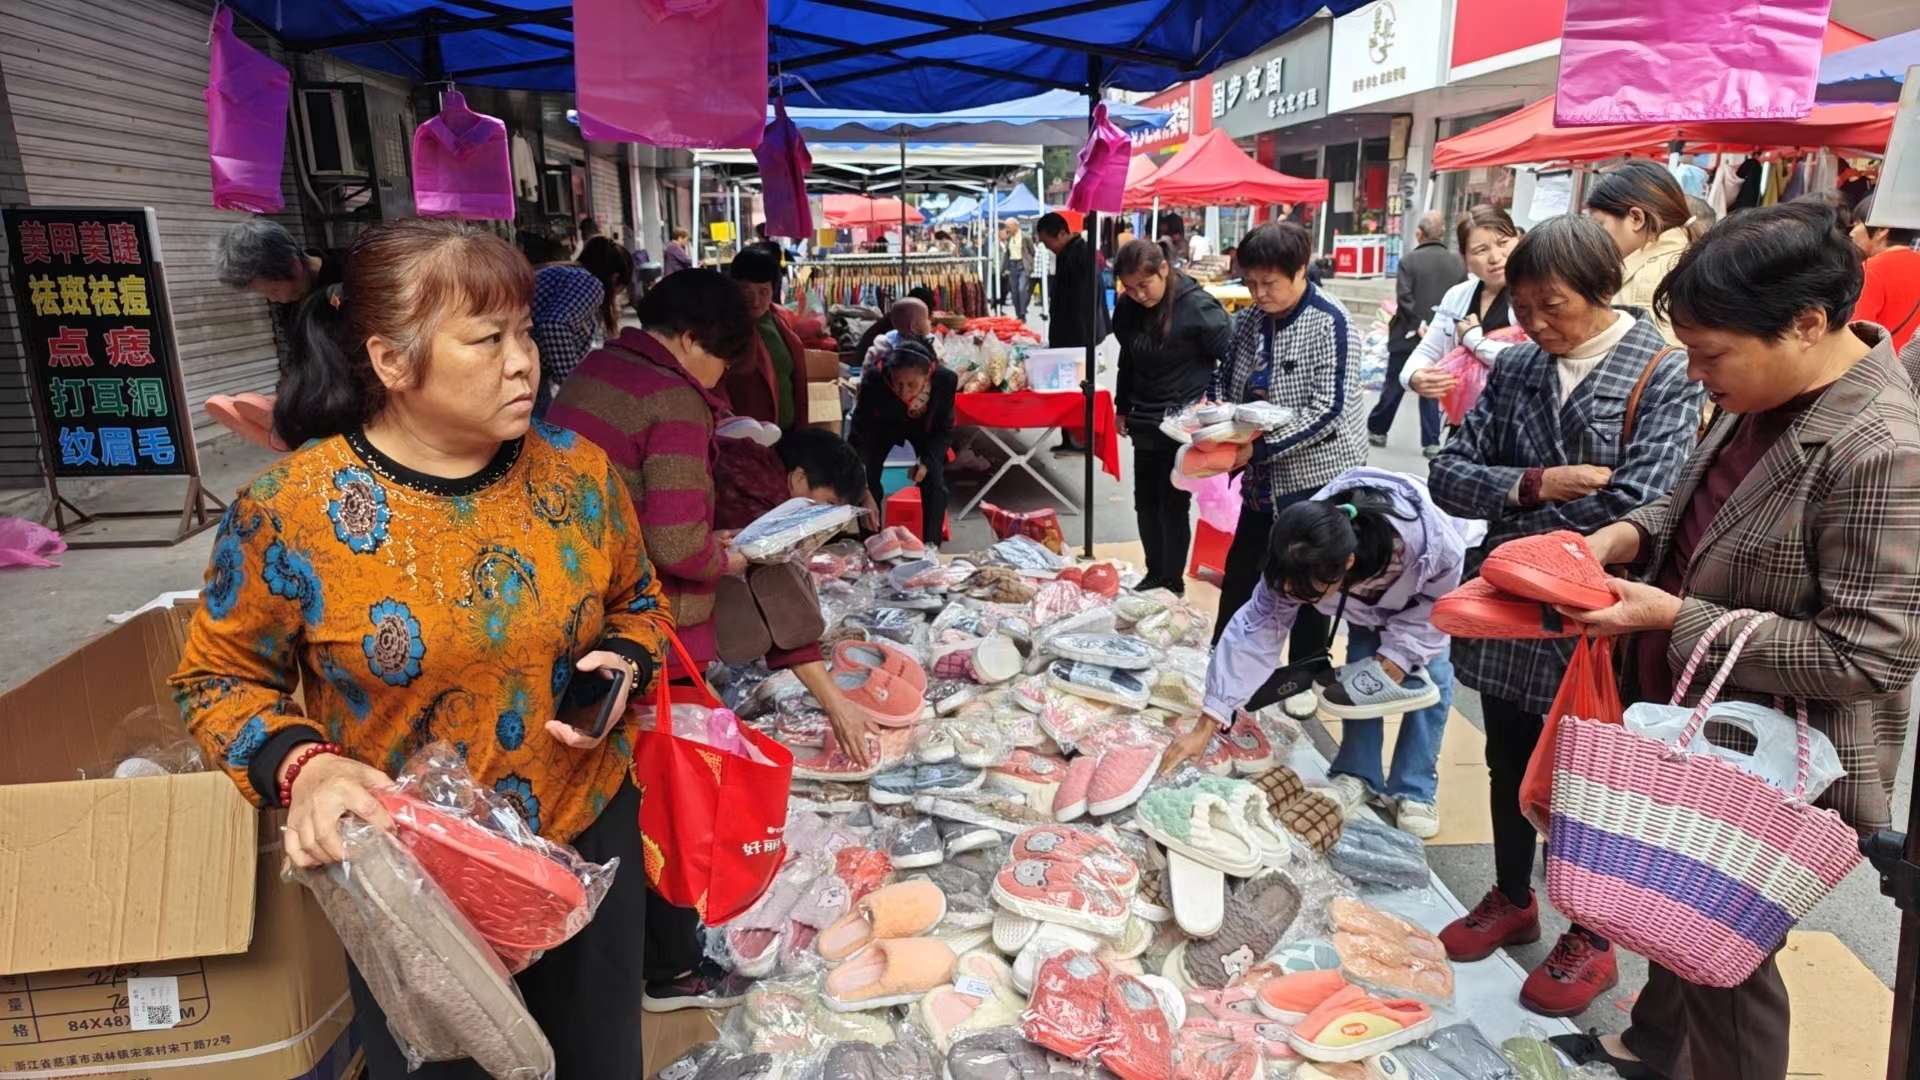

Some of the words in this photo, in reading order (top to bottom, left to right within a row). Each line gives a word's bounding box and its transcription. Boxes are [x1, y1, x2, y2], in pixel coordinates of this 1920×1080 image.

[18, 220, 142, 265] 美甲美睫
[29, 274, 150, 317] 祛斑祛痘
[50, 377, 168, 418] 打耳洞
[59, 426, 176, 467] 纹眉毛
